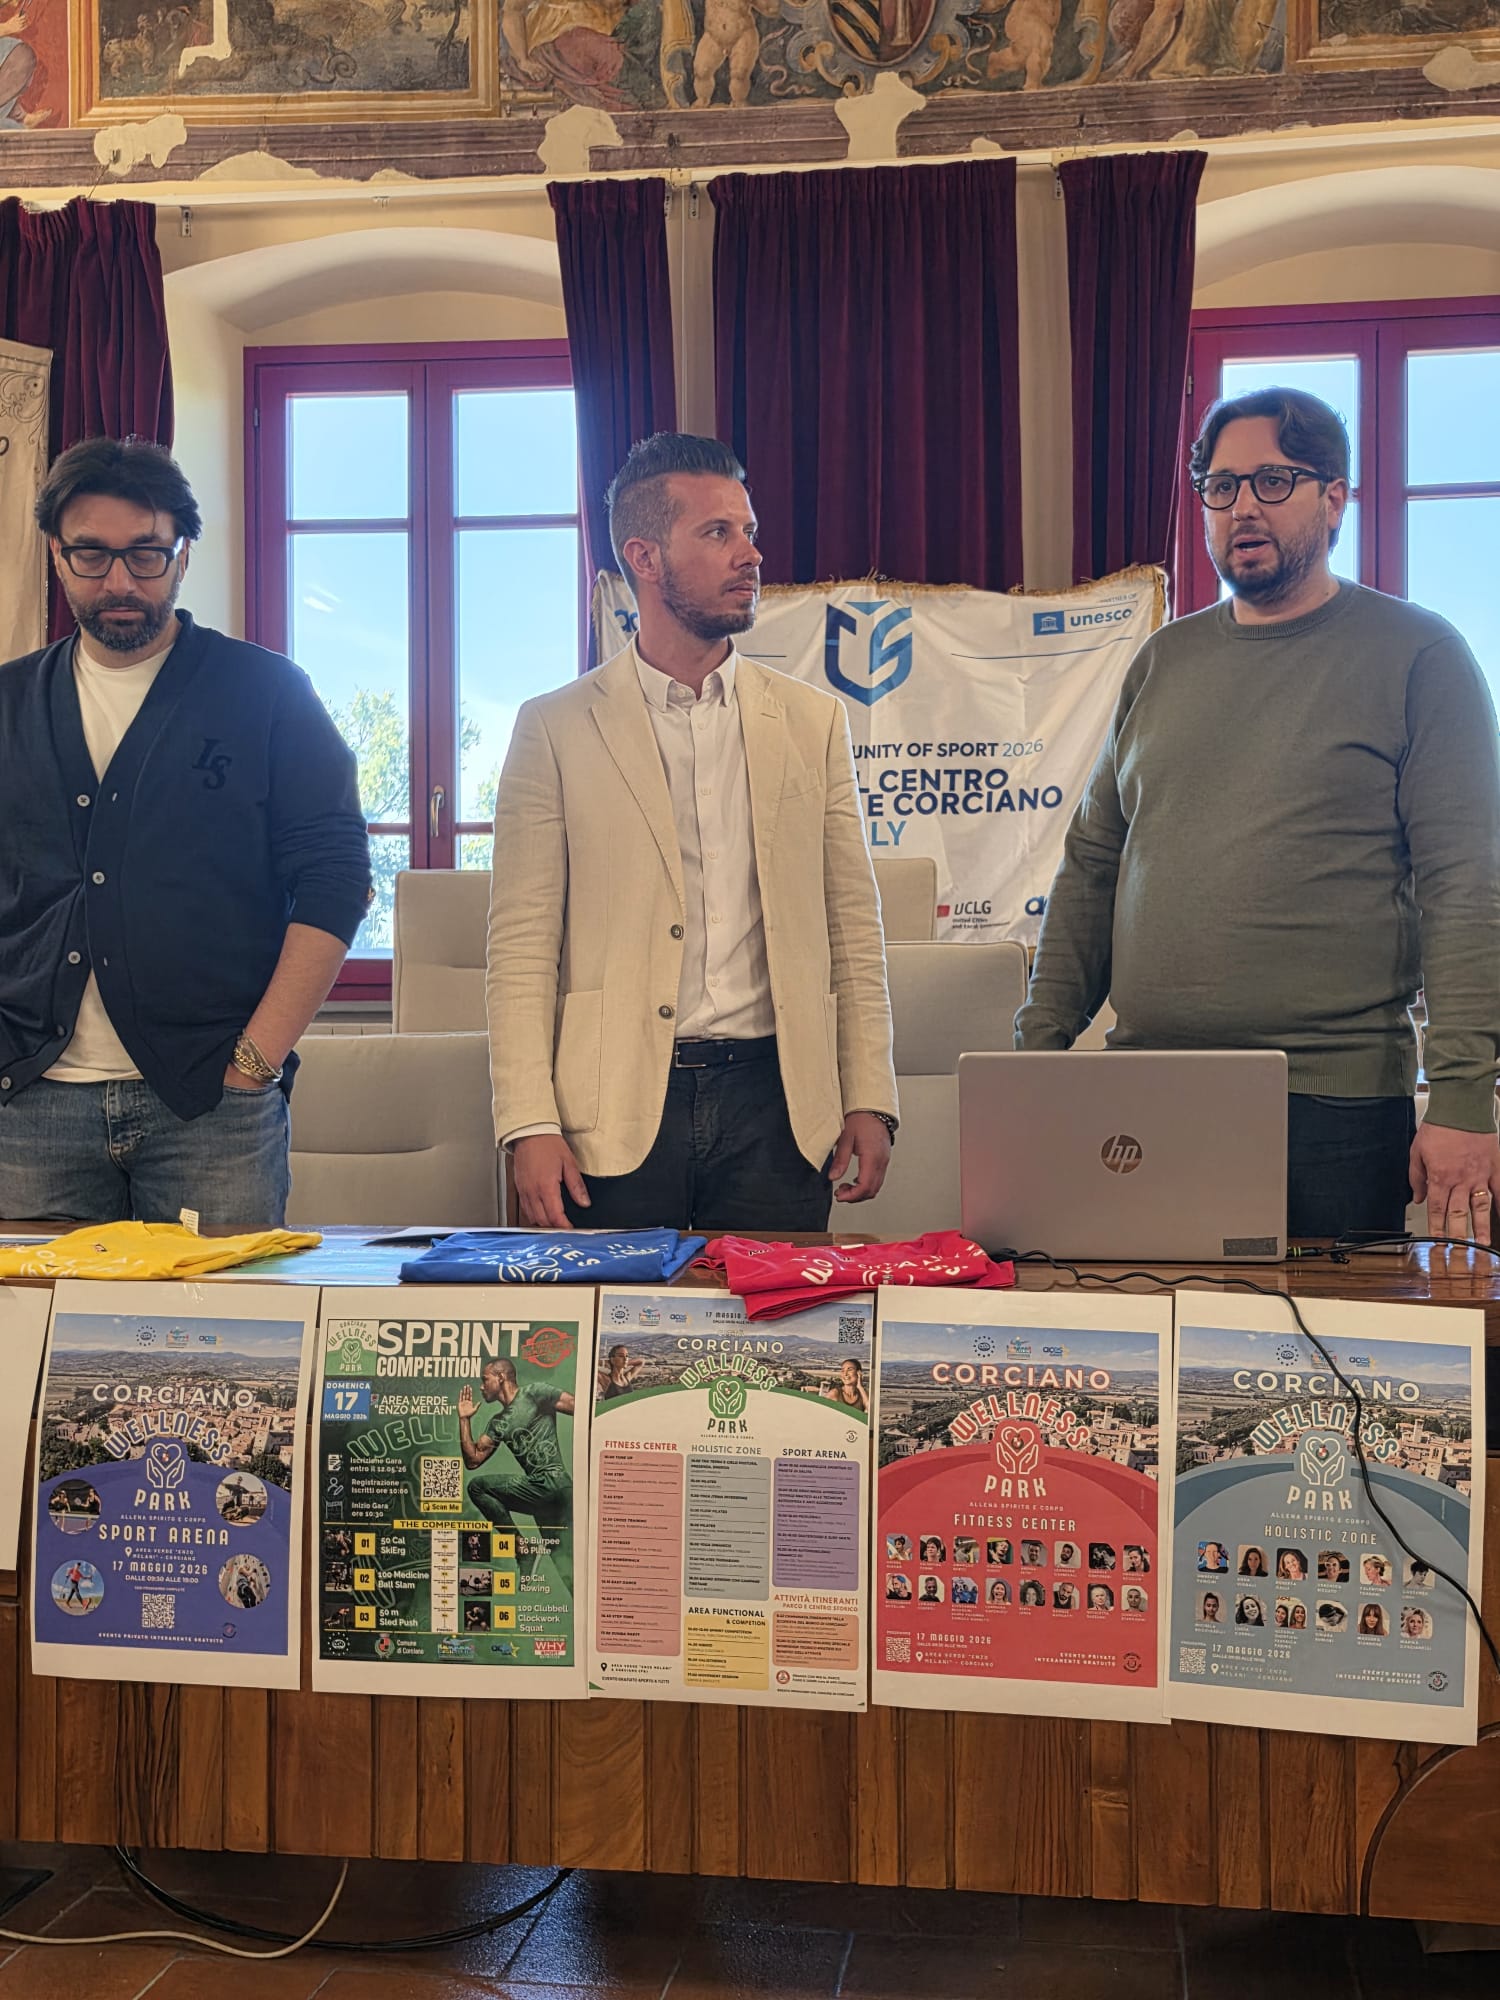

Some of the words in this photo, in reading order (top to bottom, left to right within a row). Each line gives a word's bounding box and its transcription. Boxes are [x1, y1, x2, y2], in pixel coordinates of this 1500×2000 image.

[1070, 608, 1132, 627] unesco
[852, 744, 902, 759] UNITY
[907, 743, 933, 757] OF
[937, 742, 999, 757] SPORT
[1002, 738, 1043, 757] 2026
[879, 768, 1009, 793] CENTRO
[893, 785, 1063, 816] CORCIANO
[954, 900, 992, 915] UCLG
[1107, 1135, 1138, 1174] hp
[328, 1328, 377, 1347] WELLNESS
[378, 1322, 530, 1357] SPRINT
[677, 1338, 783, 1353] CORCIANO
[377, 1356, 482, 1378] COMPETITION
[680, 1353, 777, 1391] WELLNESS
[932, 1362, 1111, 1390] CORCIANO
[1233, 1370, 1420, 1401] CORCIANO
[93, 1383, 253, 1407] CORCIANO
[335, 1392, 358, 1410] 17
[381, 1395, 410, 1405] AREA
[414, 1396, 448, 1405] VERDE
[375, 1405, 408, 1415] "ENZO
[411, 1405, 456, 1416] MELANI"
[707, 1418, 748, 1433] PARK
[949, 1391, 1091, 1448] WELLNESS
[104, 1410, 231, 1462] WELLNESS
[605, 1441, 640, 1449] FITNESS
[643, 1442, 677, 1450] CENTER
[691, 1445, 732, 1453] HOLISTIC
[736, 1447, 761, 1455] ZONE
[782, 1449, 812, 1457] SPORT
[815, 1450, 847, 1459] ARENA
[352, 1479, 400, 1487] Registrazione
[984, 1475, 1047, 1499] PARK
[134, 1489, 191, 1511] PARK
[1286, 1486, 1352, 1511] PARK
[421, 1521, 489, 1529] COMPETITION
[954, 1513, 1012, 1528] FITNESS
[1022, 1517, 1076, 1532] CENTER
[99, 1524, 157, 1542] SPORT
[169, 1527, 229, 1545] ARENA
[1264, 1525, 1332, 1541] HOLISTIC
[1342, 1531, 1377, 1545] ZONE
[361, 1539, 369, 1548] 01
[381, 1537, 391, 1545] 50
[499, 1541, 509, 1550] 04
[531, 1537, 560, 1545] Burpee
[381, 1547, 406, 1556] SkiErg
[113, 1561, 123, 1570] 17
[130, 1562, 173, 1573] MAGGIO
[180, 1564, 208, 1574] 2026
[360, 1575, 369, 1583] 02
[394, 1571, 429, 1579] Medicine
[395, 1581, 415, 1589] Slam
[500, 1579, 510, 1588] 05
[521, 1584, 550, 1593] Rowing
[774, 1594, 810, 1603] ATTIVITÀ
[813, 1597, 858, 1605] ITINERANTI
[360, 1612, 369, 1621] 03
[499, 1612, 509, 1620] 06
[713, 1608, 764, 1617] FUNCTIONAL
[930, 1633, 964, 1642] MAGGIO
[970, 1636, 991, 1644] 2026
[535, 1642, 565, 1650] WHY
[1212, 1644, 1221, 1652] 17
[1227, 1646, 1262, 1656] MAGGIO
[1336, 1673, 1384, 1682] INTERAMENTE
